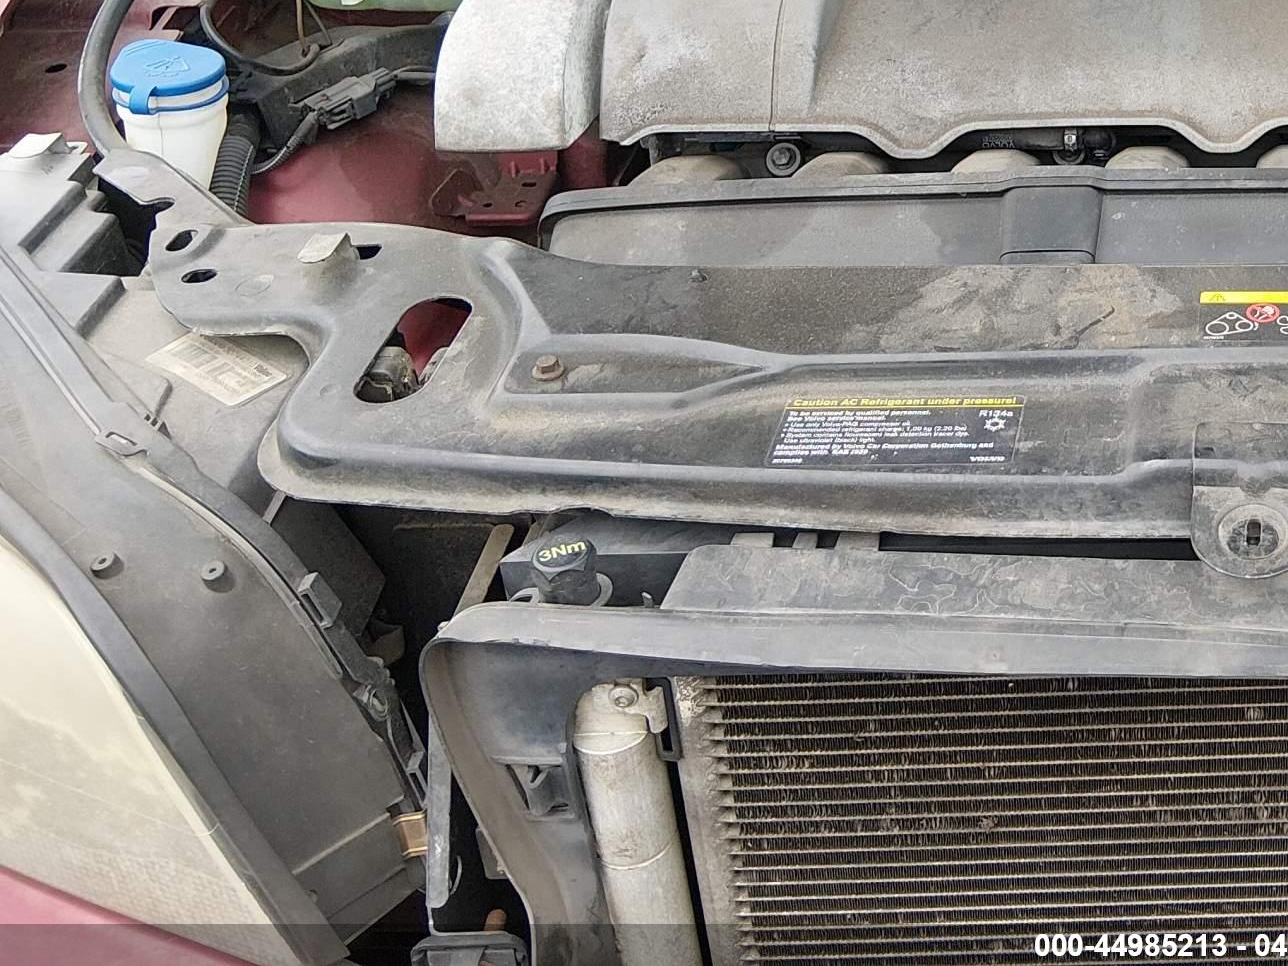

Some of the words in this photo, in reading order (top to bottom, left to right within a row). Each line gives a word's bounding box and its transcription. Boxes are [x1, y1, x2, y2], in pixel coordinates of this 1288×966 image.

[793, 398, 838, 406] Caution
[840, 398, 858, 406] AC
[860, 397, 925, 407] Refrigerant
[927, 397, 961, 405] under
[963, 396, 1017, 406] pressure!
[978, 409, 1014, 417] R134a
[538, 541, 586, 562] 3Nm
